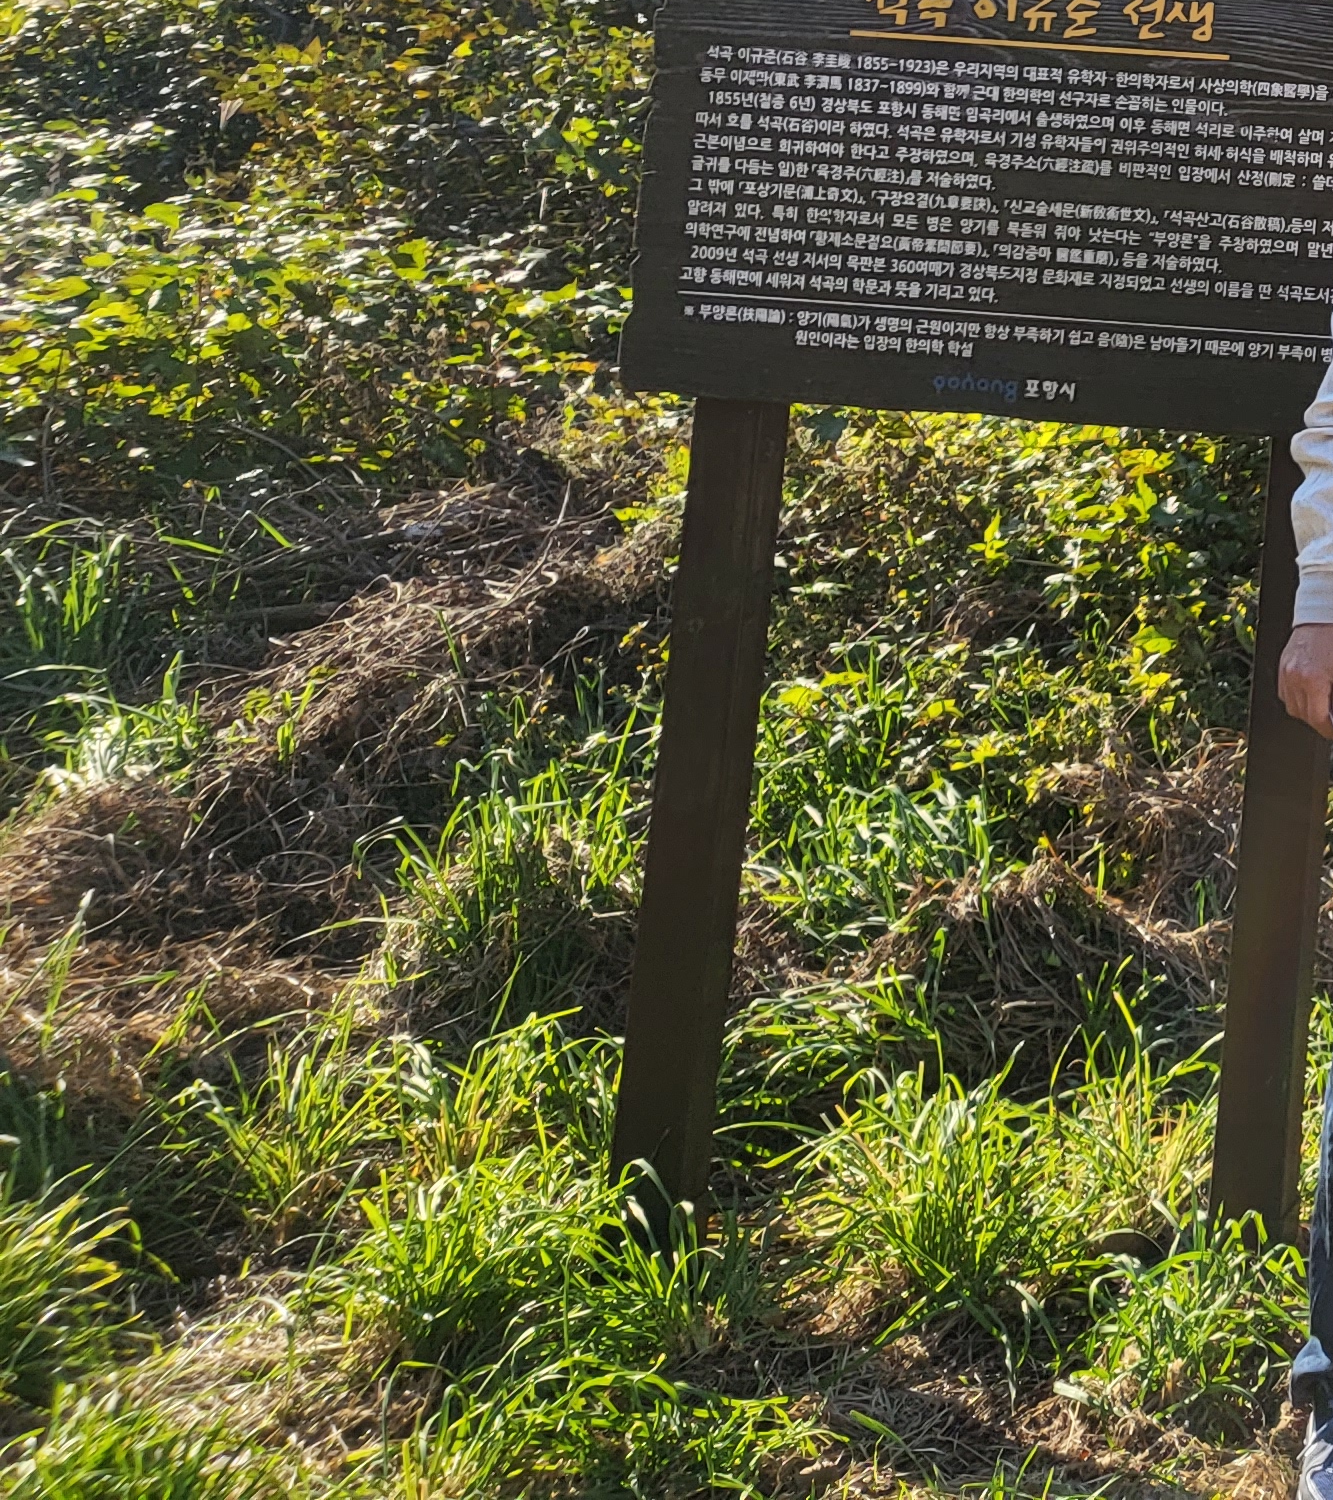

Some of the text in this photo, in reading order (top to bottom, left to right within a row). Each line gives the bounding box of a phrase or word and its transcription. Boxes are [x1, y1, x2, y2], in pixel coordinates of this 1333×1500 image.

[707, 46, 733, 61] 석곡
[953, 62, 1018, 80] 우리지역의
[1023, 67, 1062, 83] 대표적
[700, 67, 726, 83] 동무
[943, 82, 971, 100] 함께
[972, 86, 1000, 101] 근대
[1003, 87, 1055, 105] 한의학의
[1059, 91, 1111, 107] 선구자로
[1115, 95, 1168, 112] 손꼽히는
[1171, 98, 1229, 117] 인물이다.
[696, 112, 721, 127] 따서
[726, 113, 752, 129] 호를
[850, 122, 892, 138] 하였다.
[897, 125, 936, 141] 석곡은
[940, 127, 1006, 146] 유학자로서
[1010, 133, 1036, 148] 기성
[1040, 134, 1106, 153] 유학자들이
[1111, 139, 1189, 158] 권위주의적인
[1270, 150, 1323, 168] 배척하며
[710, 91, 785, 109] 1855년(철종
[790, 96, 815, 111] 6년)
[822, 98, 873, 114] 경상북도
[877, 101, 916, 118] 포항시
[922, 104, 961, 121] 동해면
[966, 107, 1031, 125] 임곡리에서
[1036, 111, 1114, 131] 출생하였으며
[1120, 118, 1146, 133] 이후
[1151, 119, 1190, 136] 동해면
[1195, 123, 1235, 138] 석리로
[1241, 125, 1292, 143] 이주하여
[1298, 129, 1324, 145] 살며
[692, 155, 731, 172] 글귀를
[735, 159, 774, 175] 다듬는
[926, 172, 995, 190] 저술하였다.
[694, 134, 772, 151] 근본이념으로
[779, 139, 844, 158] 회귀하여야
[851, 143, 889, 160] 한다고
[895, 147, 978, 167] 주장하였으며,
[1119, 163, 1171, 179] 비판적인
[1179, 166, 1230, 184] 입장에서
[689, 179, 702, 190] 그
[708, 179, 734, 195] 밖에
[685, 222, 751, 241] 의학연구에
[755, 227, 806, 244] 전념하여
[1122, 252, 1148, 268] 등을
[1152, 255, 1221, 273] 저술하였다.
[688, 200, 726, 217] 알려져
[735, 203, 763, 219] 있다.
[772, 205, 798, 222] 특히
[892, 214, 918, 230] 모든
[927, 216, 952, 232] 병은
[960, 219, 999, 235] 양기를
[1089, 228, 1141, 245] 낫는다는
[1219, 236, 1298, 256] 주창하였으며
[680, 267, 997, 303] 고향 동해면에 세워져 석곡의 학문과 뜻을 기리고 있다.
[691, 246, 737, 262] 2009년
[743, 249, 768, 264] 석곡
[773, 251, 799, 266] 선생
[803, 253, 842, 270] 저서의
[847, 255, 886, 272] 목판본
[890, 259, 954, 277] 360여매가
[960, 263, 1037, 283] 경상북도지정
[1043, 269, 1095, 286] 문화재로
[1100, 274, 1165, 291] 지정되었고
[1171, 279, 1209, 295] 선생의
[1215, 281, 1253, 298] 이름을
[1259, 285, 1272, 299] 딴
[796, 330, 973, 357] 원인이라는 입장의 한의학 학설
[874, 317, 912, 333] 생명의
[916, 320, 980, 337] 근원이지만
[985, 324, 1010, 339] 항상
[1013, 326, 1064, 344] 부족하기
[1069, 330, 1093, 345] 쉽고
[1151, 336, 1201, 354] 남아돌기
[1205, 340, 1244, 356] 때문에
[1248, 343, 1273, 358] 양기
[1278, 345, 1316, 361] 부족이
[1023, 378, 1077, 402] 포항시
